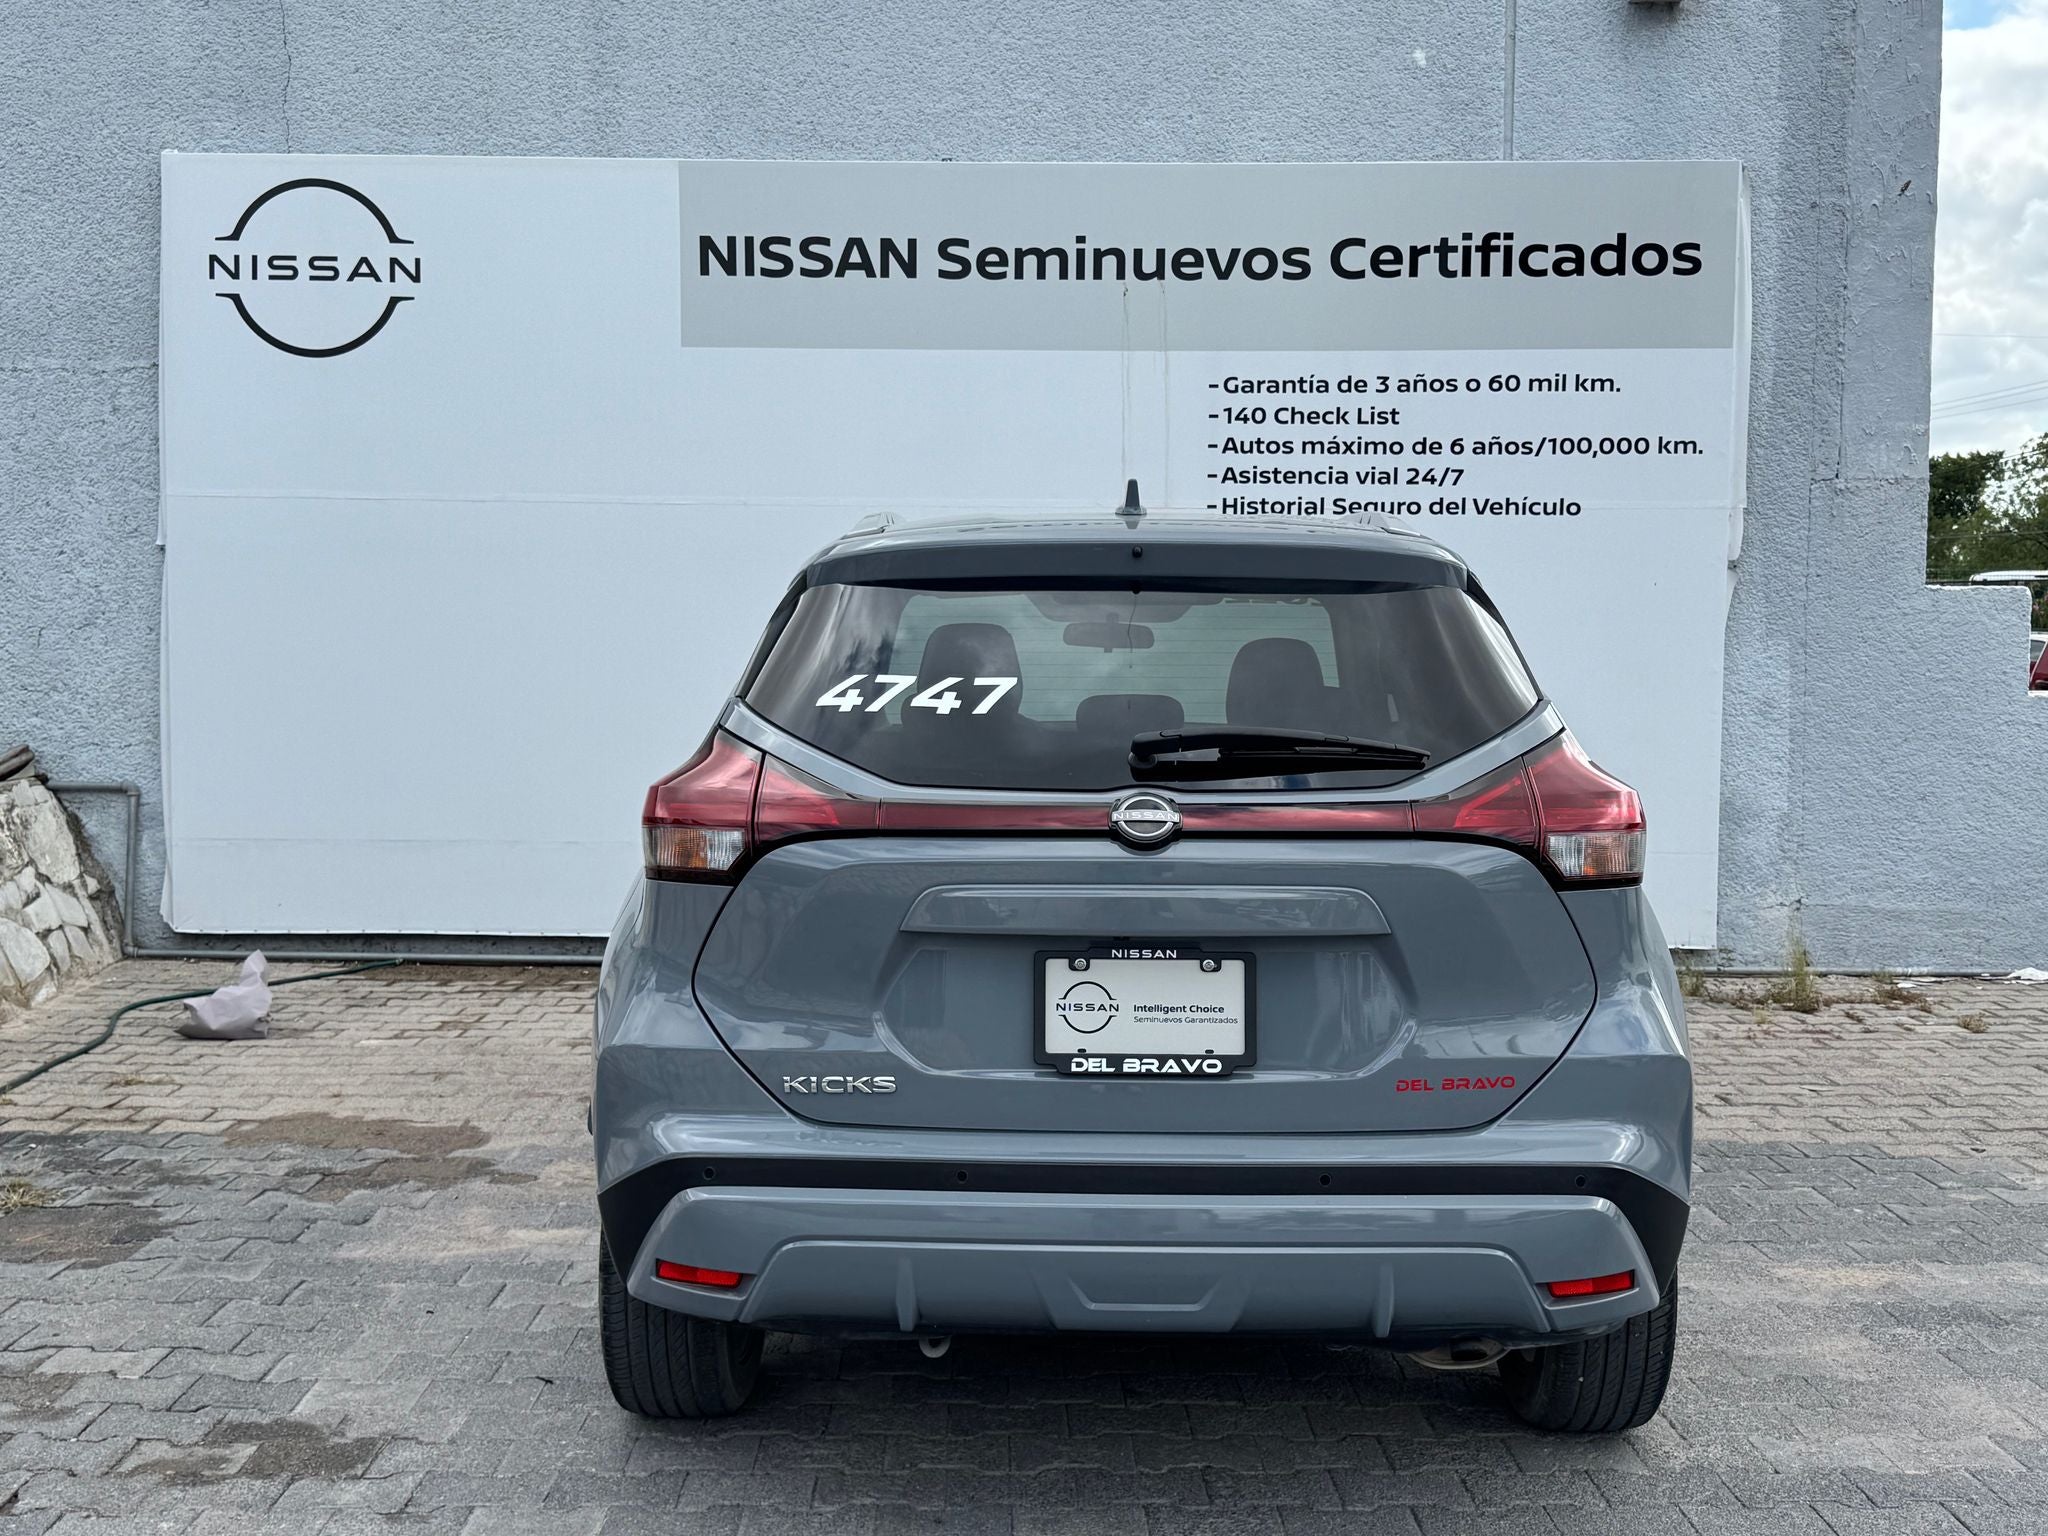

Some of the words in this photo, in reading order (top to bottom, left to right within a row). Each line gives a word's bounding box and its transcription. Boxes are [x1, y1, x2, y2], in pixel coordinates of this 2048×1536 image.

[699, 235, 918, 279] NISSAN
[937, 235, 1312, 282] Seminuevos
[1329, 231, 1703, 281] Certificados
[208, 254, 421, 284] NISSAN
[1336, 375, 1368, 394] de
[1375, 375, 1390, 394] 3
[1396, 373, 1459, 393] años
[1465, 378, 1481, 393] o
[1488, 374, 1521, 393] 60
[1528, 373, 1567, 392] mil
[1574, 373, 1621, 393] km.
[1273, 406, 1350, 425] Check
[1357, 406, 1400, 426] List
[1301, 435, 1405, 456] máximo
[1411, 436, 1443, 456] de
[1449, 437, 1465, 456] 6
[1471, 435, 1650, 459] años/100,000
[1657, 435, 1704, 455] km.
[1355, 466, 1399, 486] vial
[1405, 466, 1465, 487] 24/7
[1428, 496, 1467, 516] del
[1472, 496, 1582, 516] Vehículo
[815, 674, 1018, 716] 4747
[1113, 811, 1178, 821] NISSAN
[1111, 949, 1177, 959] NISSAN
[1055, 1002, 1120, 1013] NISSAN
[1133, 1004, 1187, 1016] Intelligent
[1189, 1004, 1225, 1014] Choice
[1133, 1015, 1183, 1024] Seminuevos
[1184, 1016, 1239, 1025] Garantizados
[1070, 1057, 1116, 1073] DEL
[1122, 1058, 1223, 1074] BRAVO
[782, 1075, 896, 1094] KICKS
[1395, 1078, 1434, 1093] DEL
[1441, 1075, 1516, 1091] BRAVO
